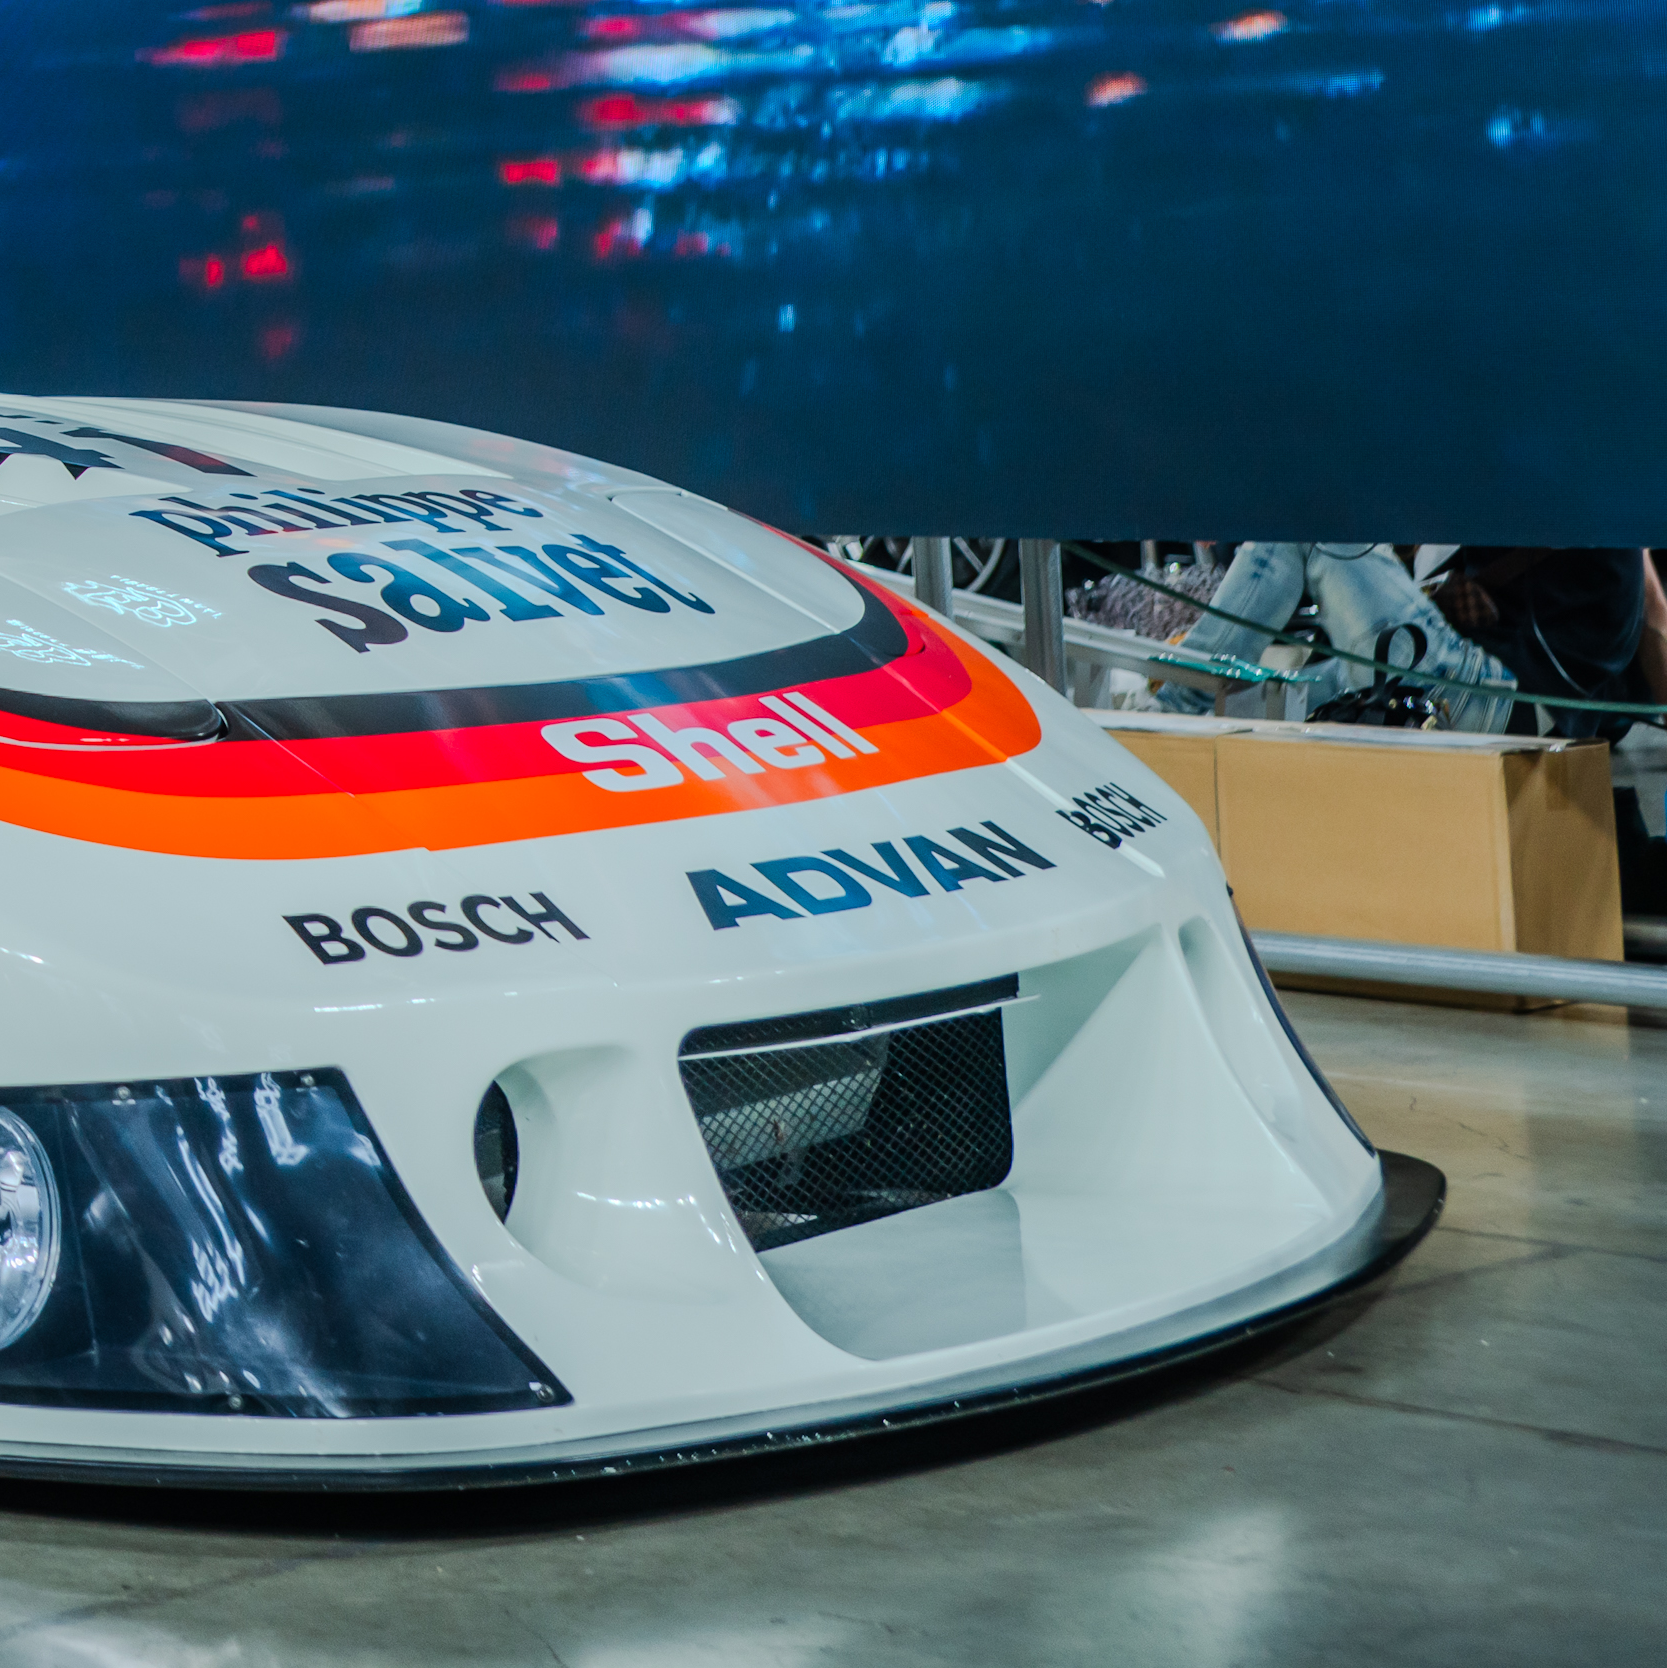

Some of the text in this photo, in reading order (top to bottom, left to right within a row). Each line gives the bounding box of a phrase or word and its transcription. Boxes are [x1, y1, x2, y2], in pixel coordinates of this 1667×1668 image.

[130, 482, 545, 558] philippe
[247, 532, 716, 654] salvet
[541, 690, 880, 793] Shell
[1055, 782, 1169, 850] BOSCH
[685, 820, 1058, 931] ADVAN
[282, 891, 592, 966] BOSCH
